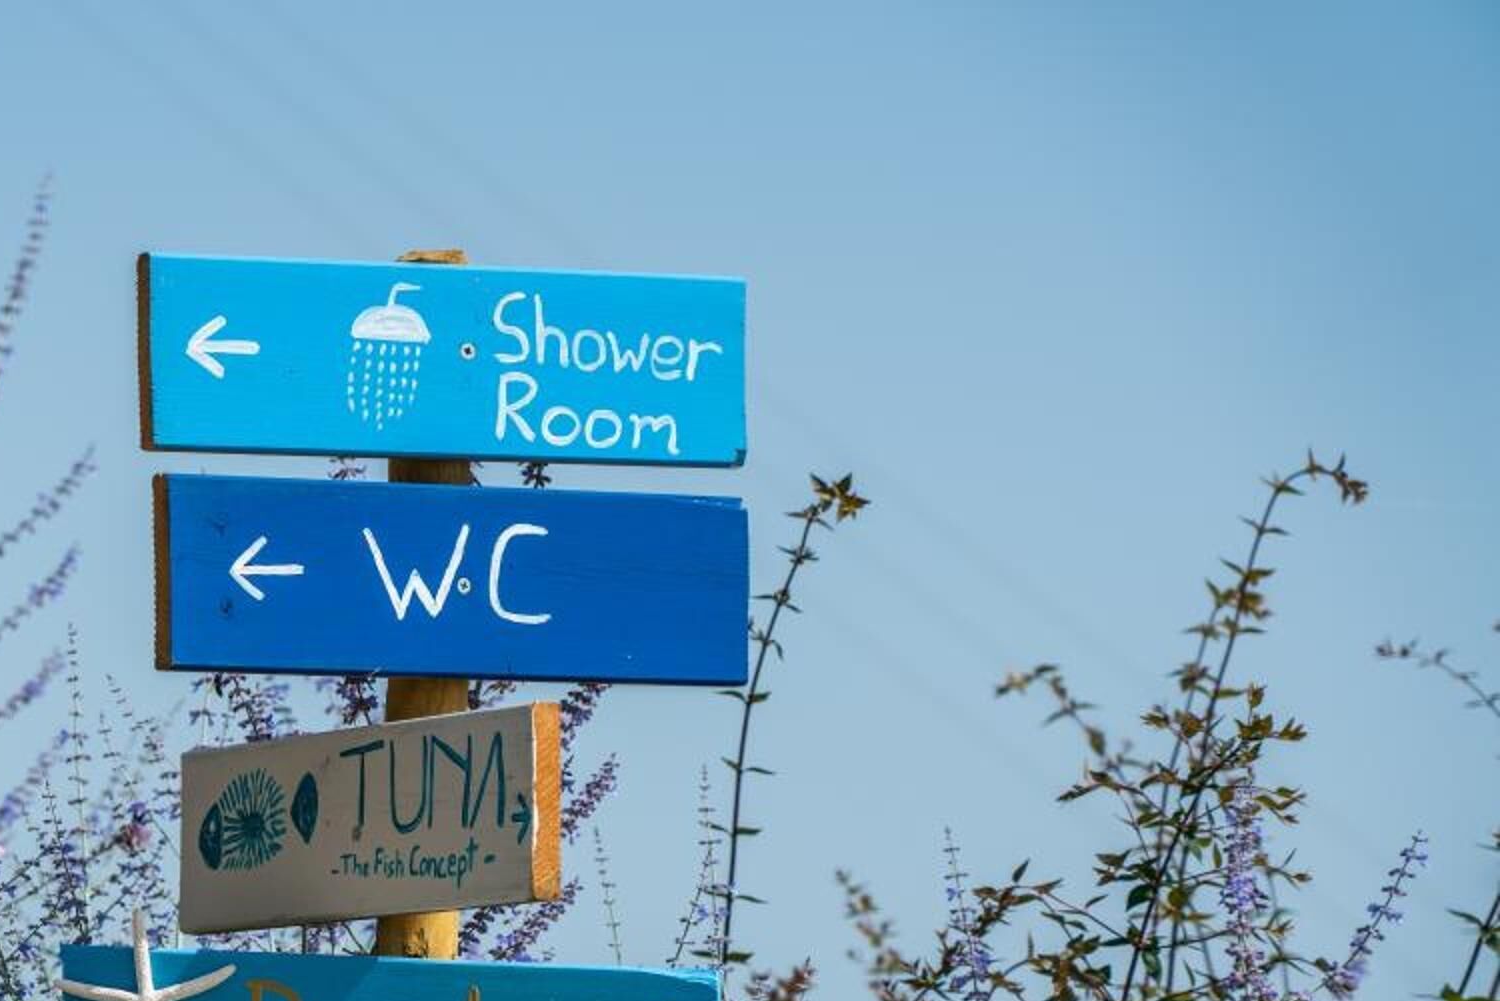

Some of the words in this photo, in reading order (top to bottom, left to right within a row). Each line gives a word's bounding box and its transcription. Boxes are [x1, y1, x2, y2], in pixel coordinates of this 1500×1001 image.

[492, 291, 723, 382] Shower
[495, 371, 680, 455] Room
[339, 730, 505, 835] TUNA
[373, 847, 405, 878] Fish
